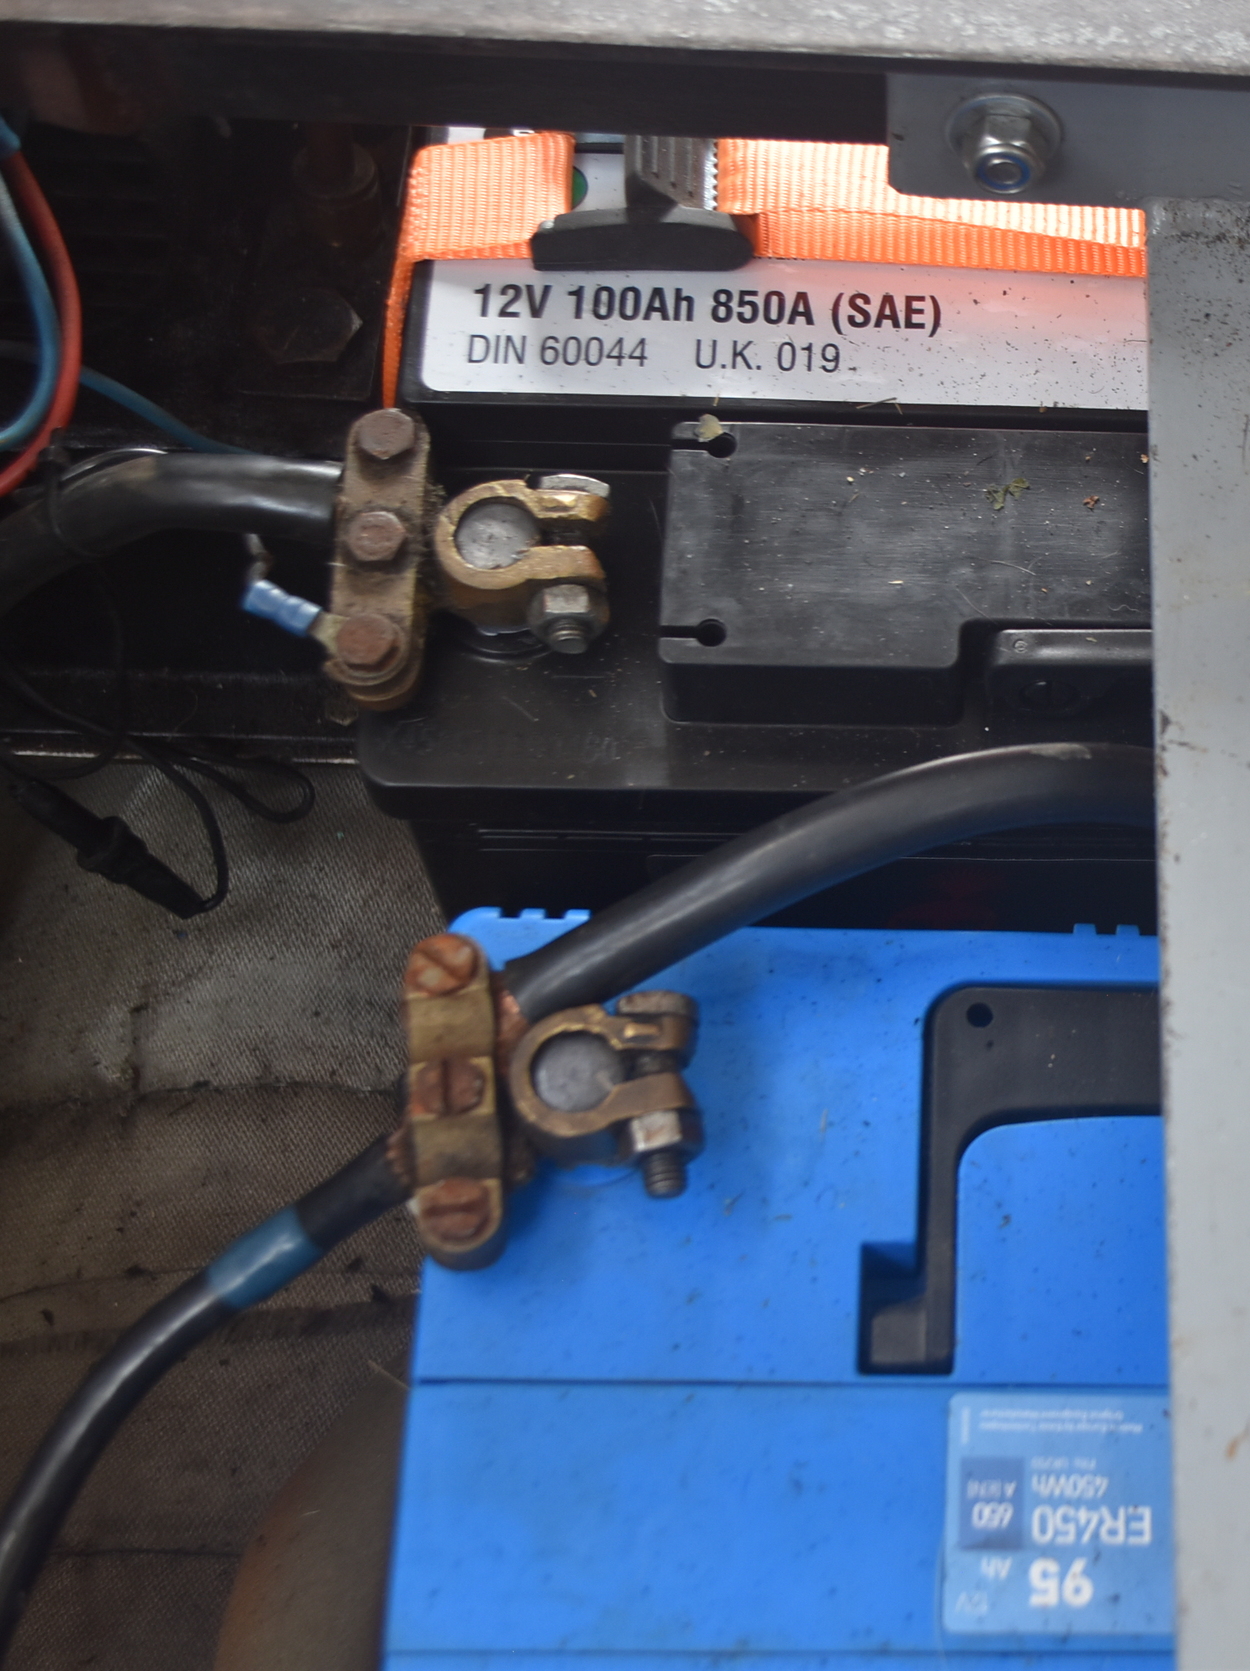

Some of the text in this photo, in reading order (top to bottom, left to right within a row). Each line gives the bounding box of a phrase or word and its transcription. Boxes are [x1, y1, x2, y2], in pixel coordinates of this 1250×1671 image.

[473, 283, 942, 338] 12V 100Ah 850A (SAE)
[467, 334, 840, 374] DIN 60044 U.K. 019
[1031, 1473, 1109, 1500] 450Wh
[1031, 1505, 1152, 1546] ER450
[1028, 1556, 1095, 1607] 95
